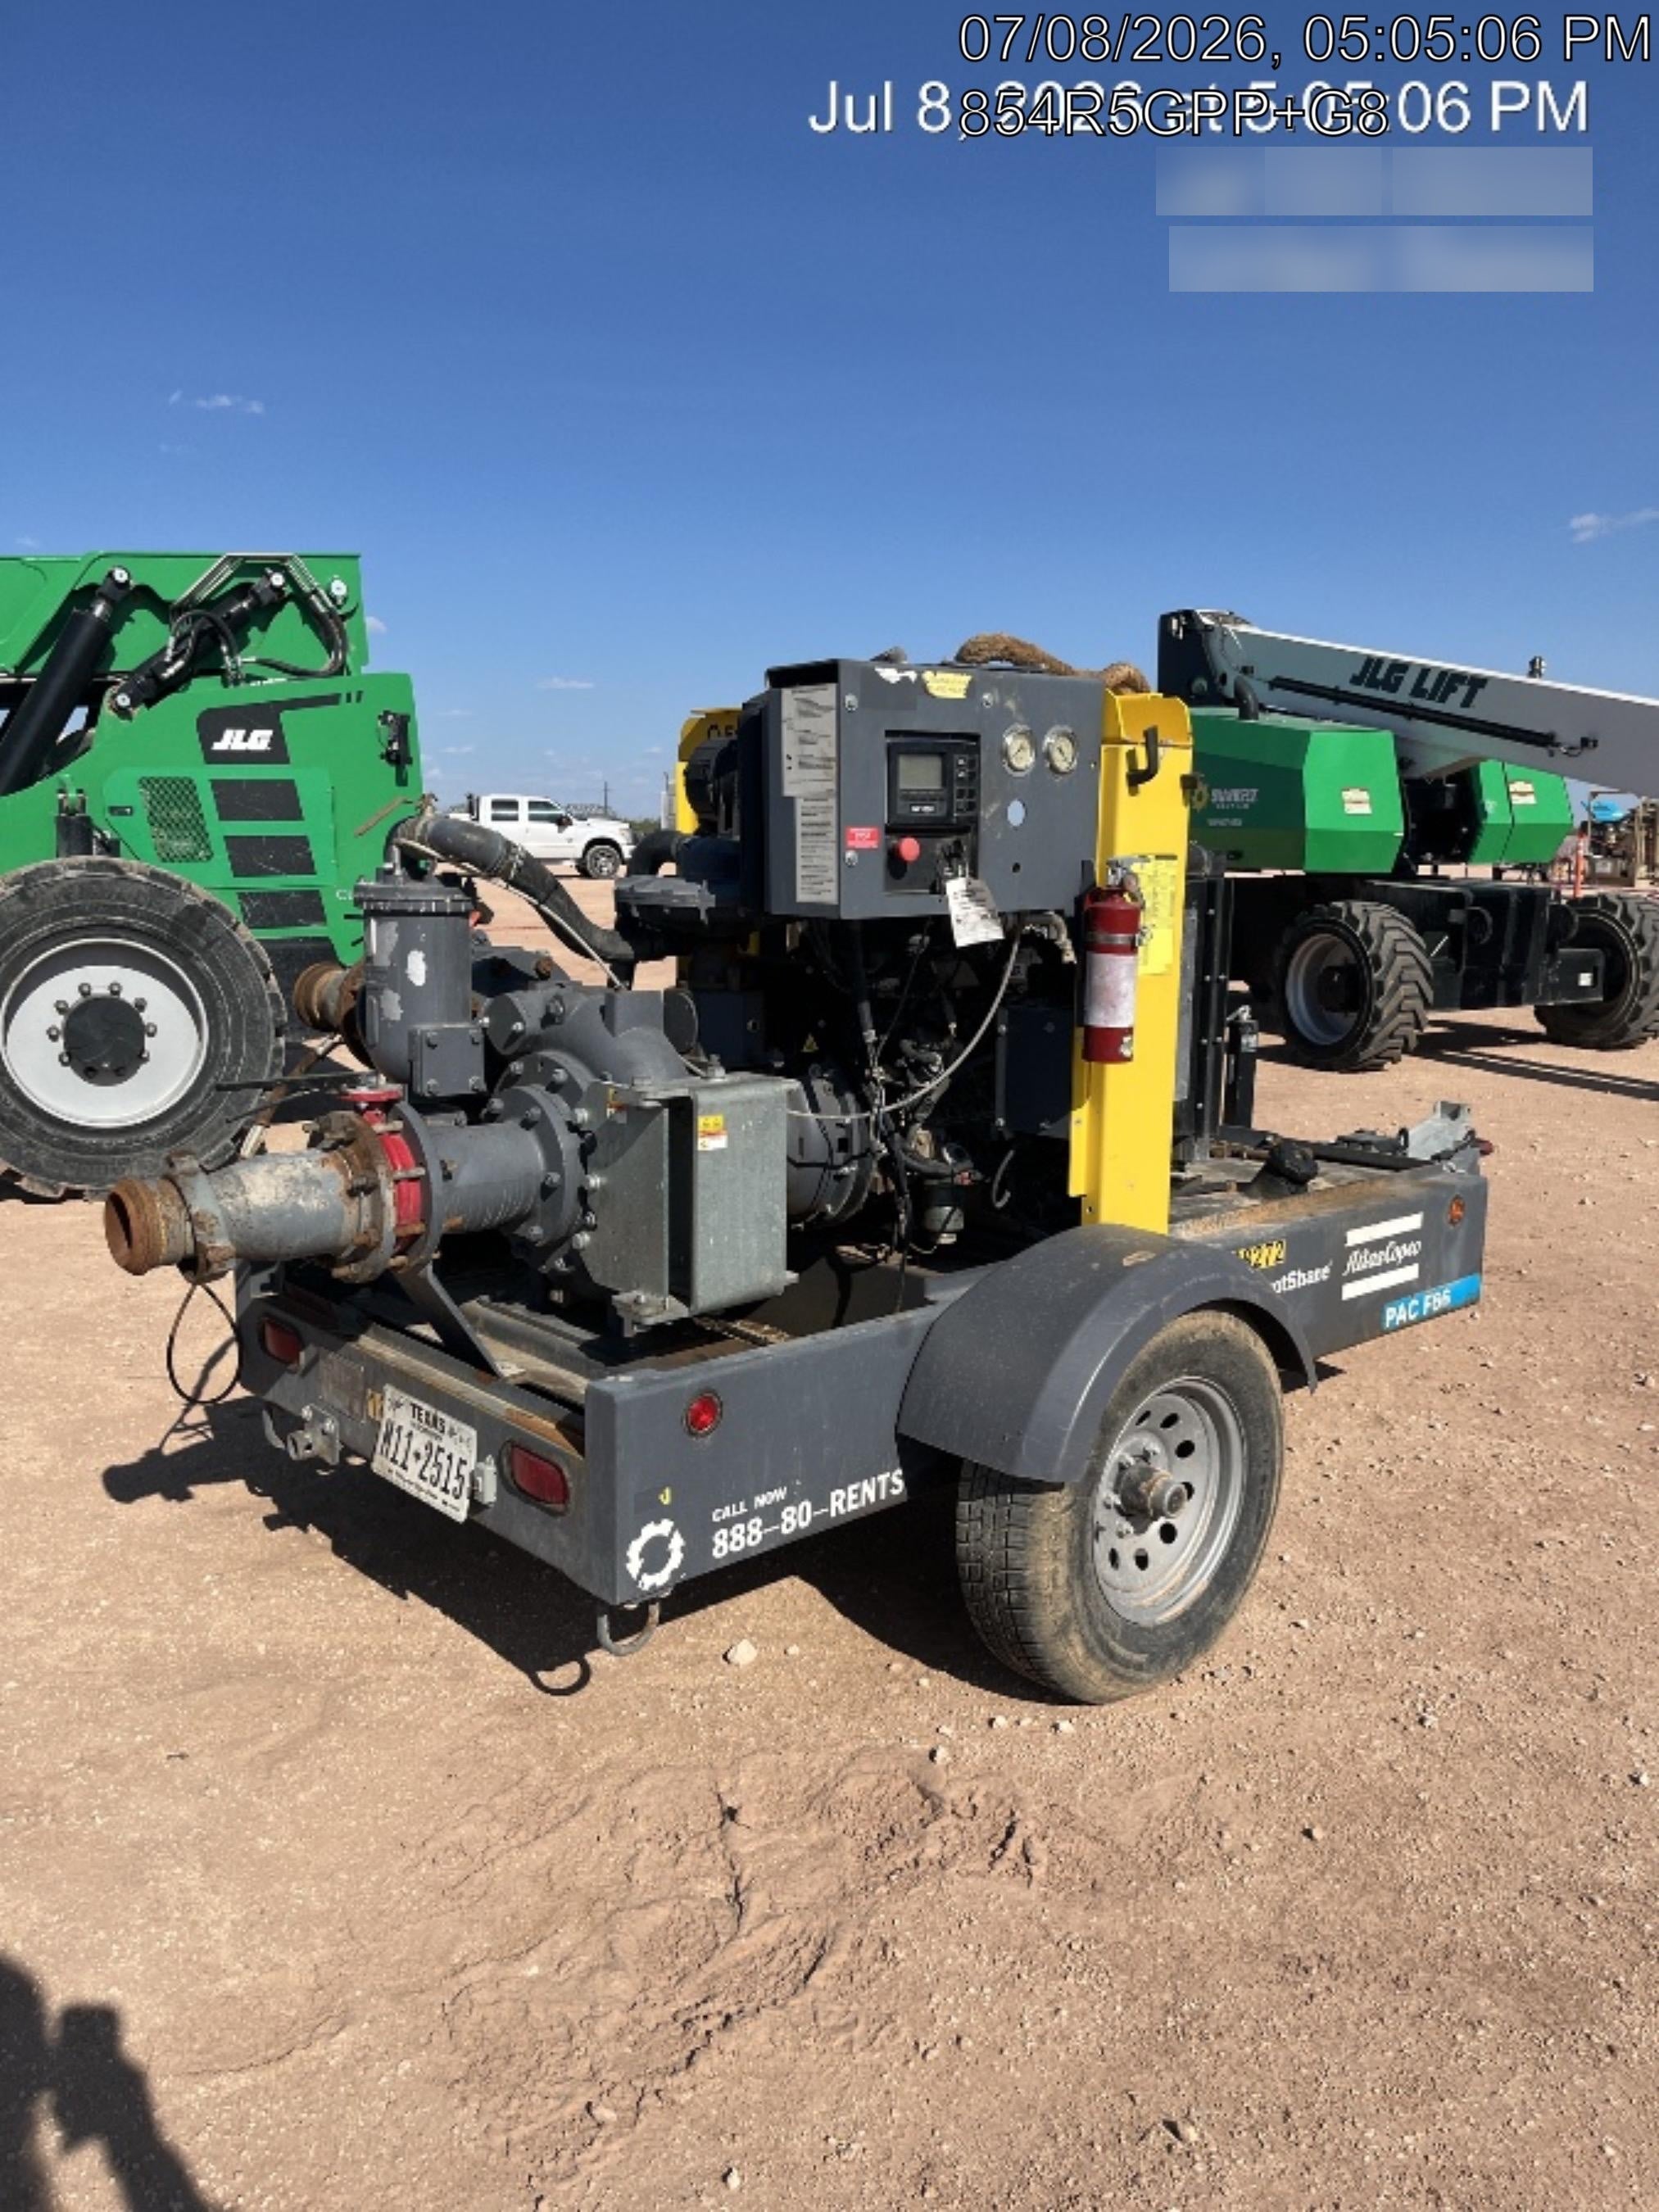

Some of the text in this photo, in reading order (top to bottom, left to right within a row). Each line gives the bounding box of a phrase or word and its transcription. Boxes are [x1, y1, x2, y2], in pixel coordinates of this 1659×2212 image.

[1349, 655, 1489, 709] JLG LIFT
[211, 728, 274, 750] JLG
[1385, 1299, 1420, 1328] PAC
[712, 1486, 787, 1523] CALL NOW
